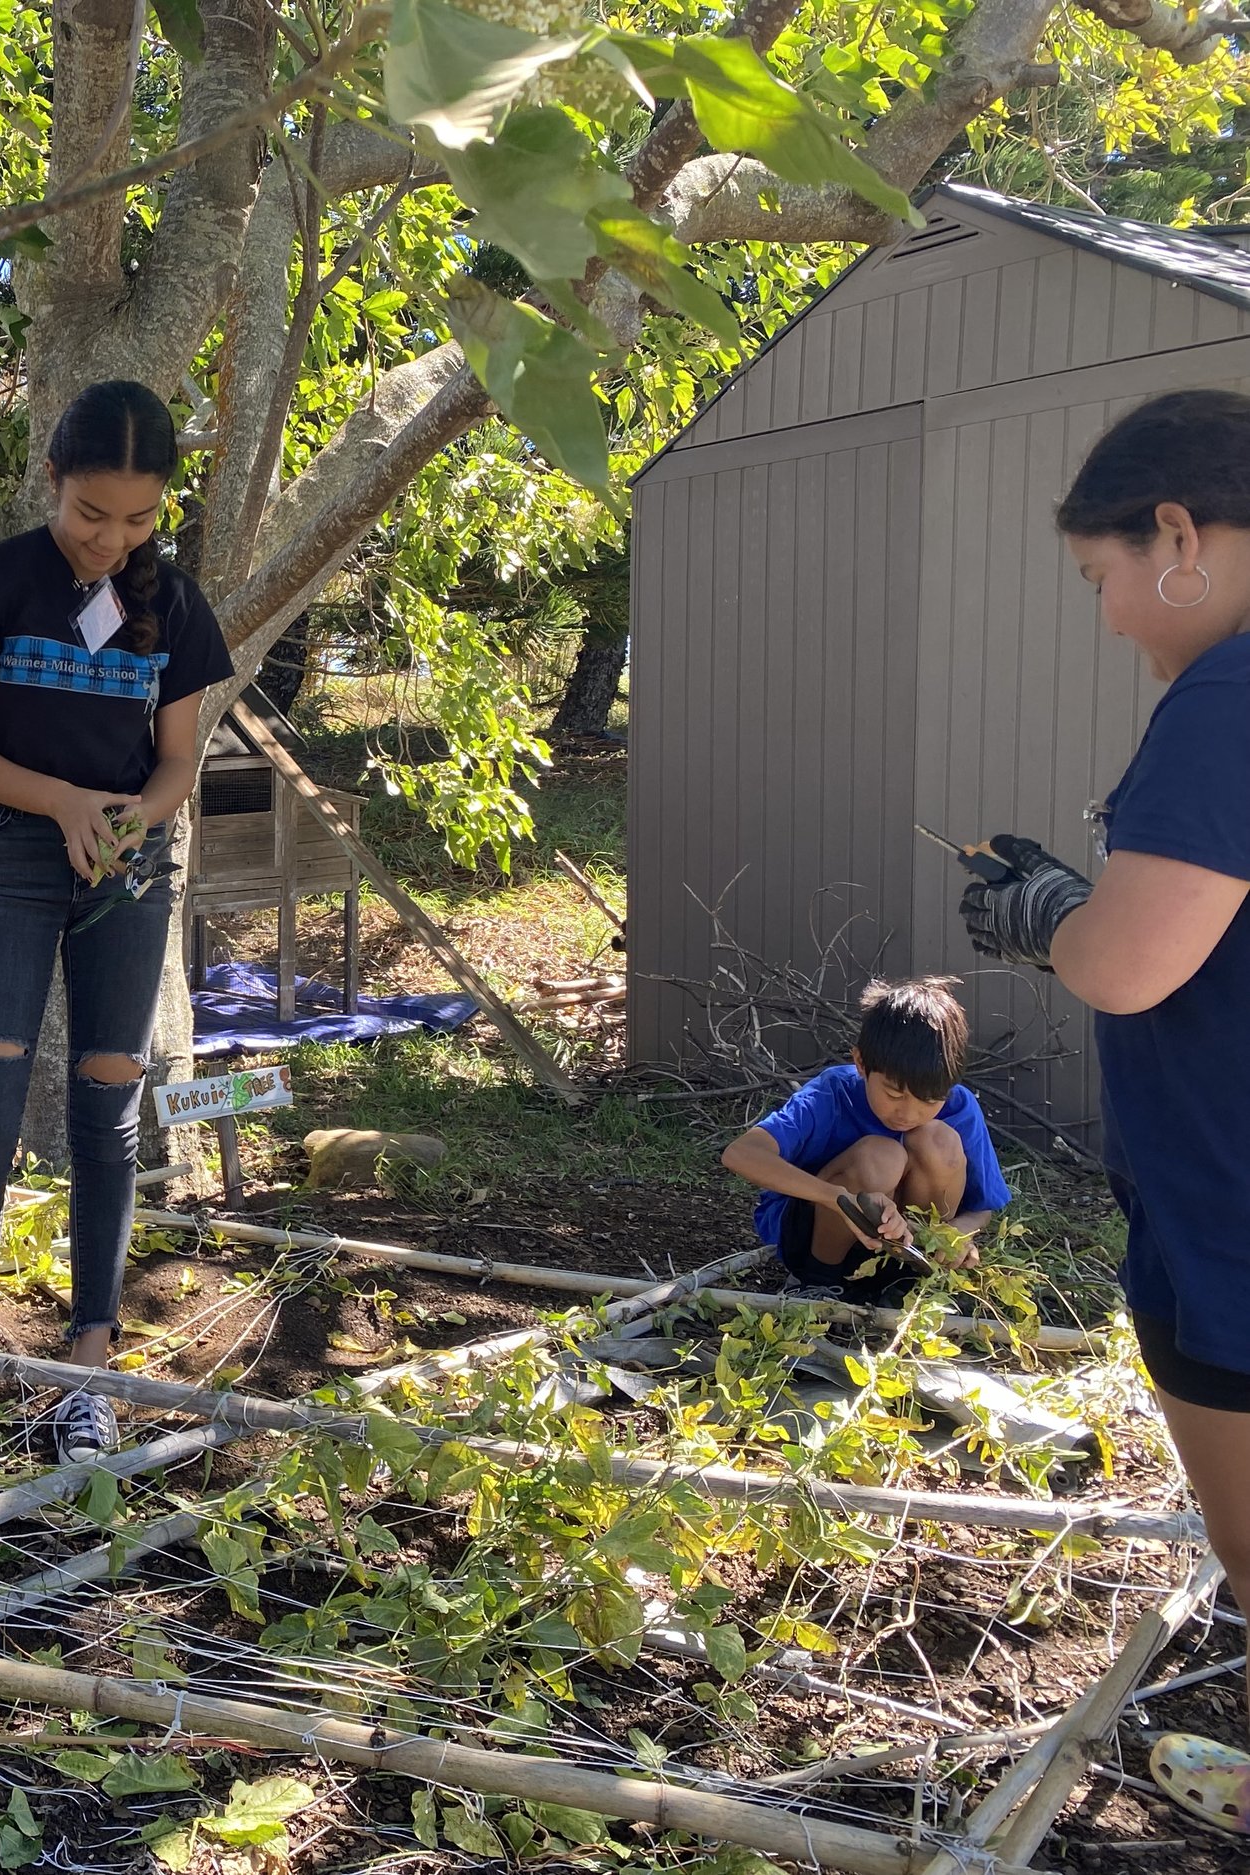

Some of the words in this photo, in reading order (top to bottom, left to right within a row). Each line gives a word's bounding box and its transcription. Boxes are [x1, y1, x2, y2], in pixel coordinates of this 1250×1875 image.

[2, 655, 47, 669] Waimea
[51, 659, 95, 677] Middle
[97, 666, 139, 681] School
[243, 1072, 276, 1098] TREE
